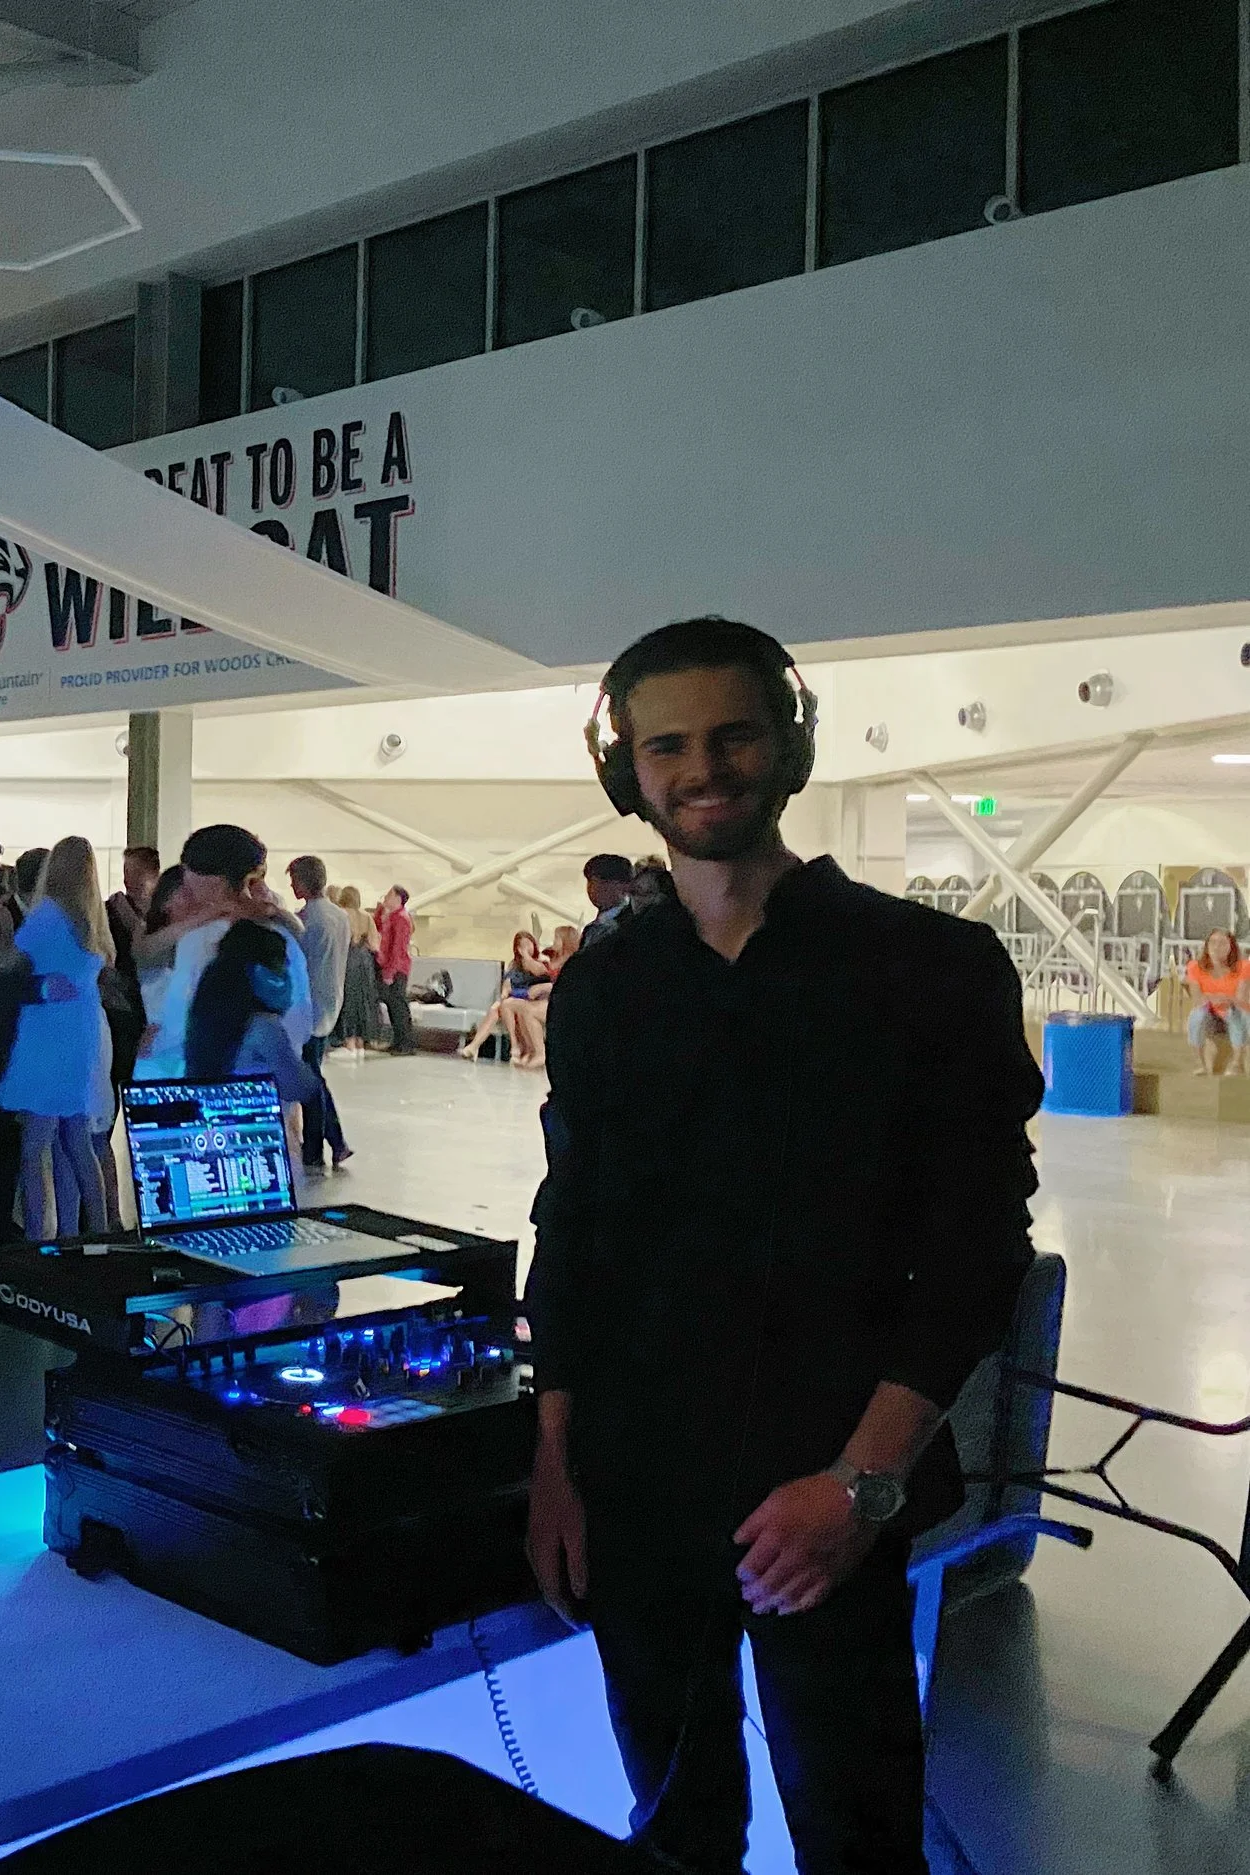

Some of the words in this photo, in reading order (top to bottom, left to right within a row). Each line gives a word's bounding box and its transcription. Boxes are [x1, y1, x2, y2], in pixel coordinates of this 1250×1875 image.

[246, 437, 297, 513] TO
[312, 420, 366, 499] BE
[380, 411, 412, 485] A
[61, 672, 102, 689] PROUD
[106, 664, 169, 684] PROVIDER
[173, 661, 200, 677] FOR
[205, 653, 261, 673] WOODS
